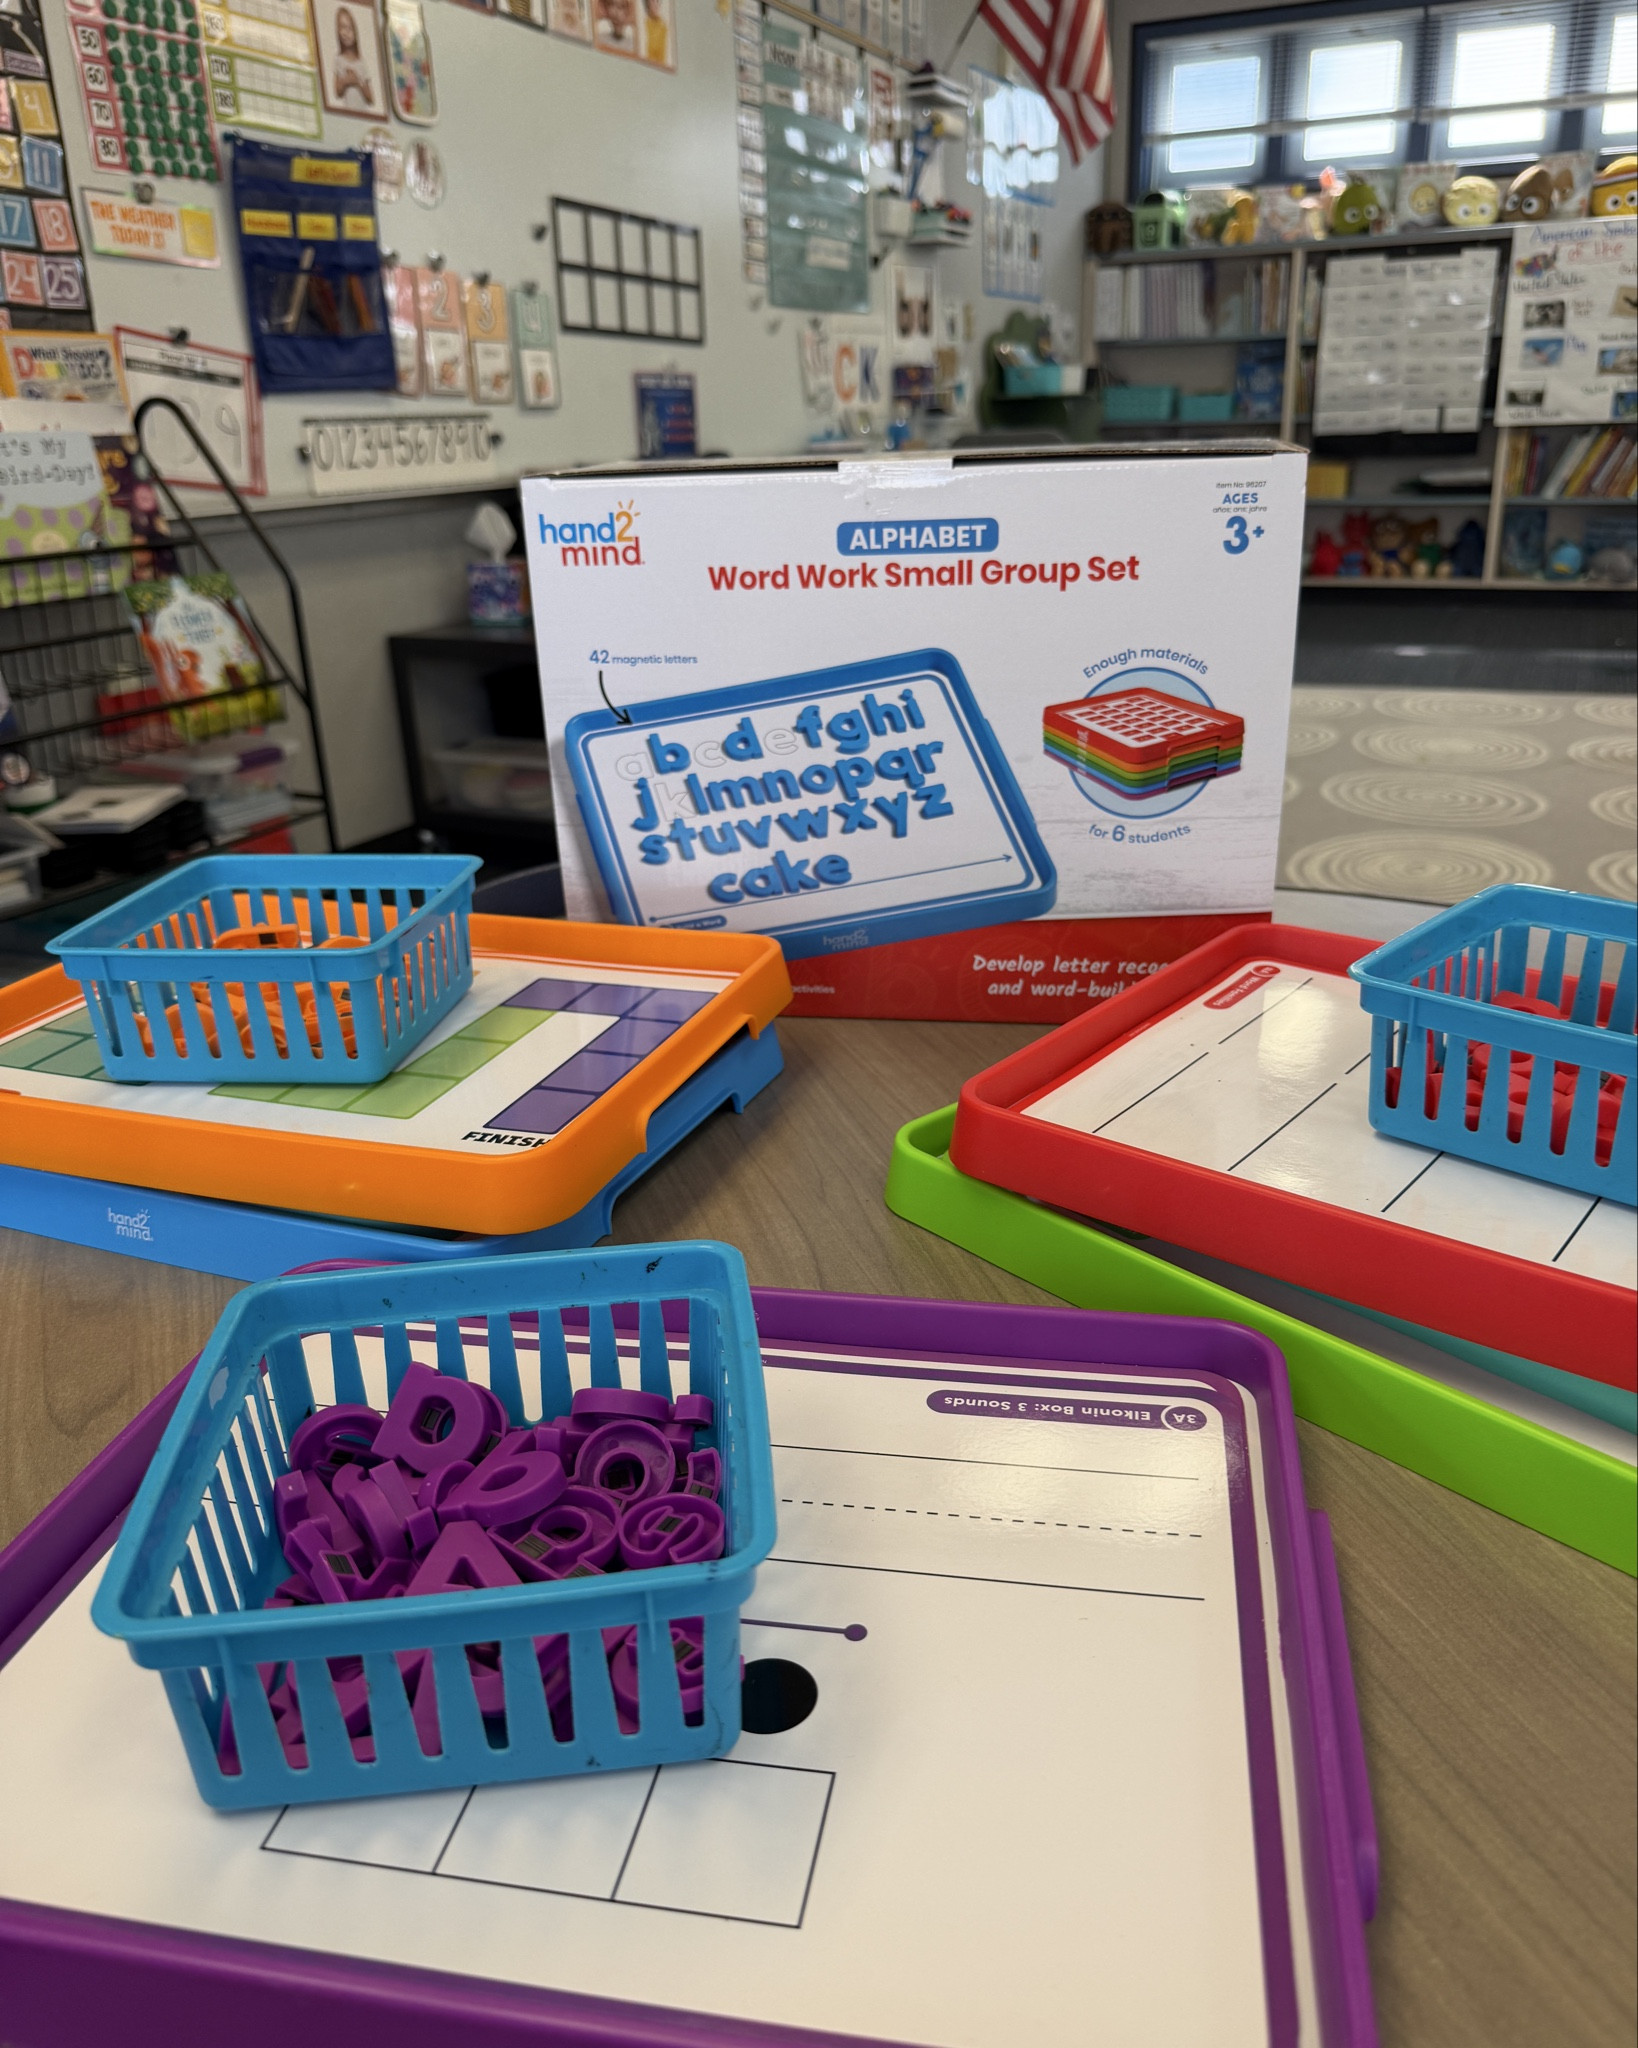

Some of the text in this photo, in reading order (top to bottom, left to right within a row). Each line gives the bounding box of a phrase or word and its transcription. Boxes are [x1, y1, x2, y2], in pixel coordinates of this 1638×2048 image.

[23, 88, 46, 126] 4
[93, 103, 112, 123] 70
[42, 207, 67, 242] 18
[7, 257, 39, 295] 24
[46, 260, 81, 300] 25
[1222, 492, 1259, 504] AGES
[849, 524, 988, 550] ALPHABET
[708, 555, 1140, 592] Word Work Small Group Set
[589, 650, 698, 667] 42 magnetic letters
[1083, 648, 1210, 680] Enough materials
[1088, 823, 1192, 844] for 6 students
[706, 849, 853, 904] cake
[972, 954, 1046, 977] Develop
[1053, 955, 1110, 974] letter
[987, 979, 1024, 996] and
[460, 1131, 552, 1148] FINISH
[944, 1396, 1151, 1421] Elkonin Box: 3 Sounds
[1173, 1412, 1197, 1424] 3A
